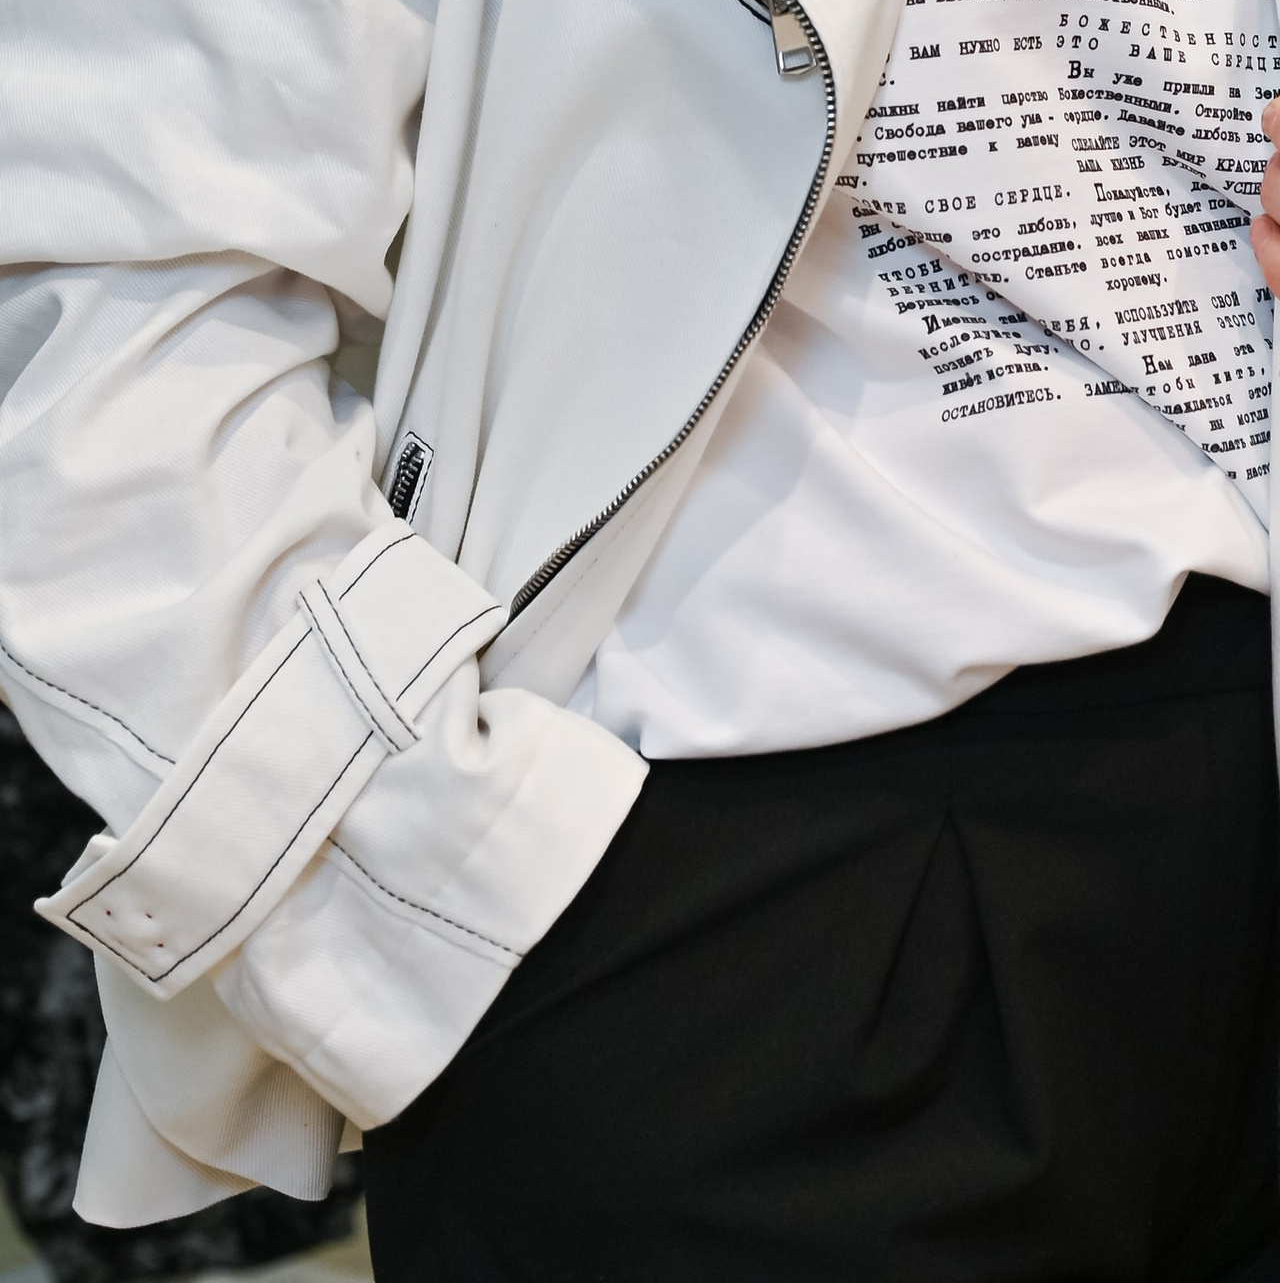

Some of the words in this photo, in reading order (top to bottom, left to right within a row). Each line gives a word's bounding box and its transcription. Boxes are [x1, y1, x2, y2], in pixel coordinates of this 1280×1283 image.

[909, 44, 941, 60] ВАМ
[959, 38, 1000, 55] НУЖНО
[1013, 36, 1042, 51] ЕСТЬ
[1057, 35, 1098, 50] ЭТО
[1129, 44, 1186, 63] ВАШЕ
[1067, 60, 1095, 79] Вы
[1112, 73, 1143, 86] уже
[1163, 81, 1215, 95] пришли
[1229, 87, 1241, 98] на
[937, 96, 986, 112] найти
[1001, 91, 1048, 106] царство
[1058, 84, 1182, 114] Божественными.
[1195, 104, 1252, 122] Откройте
[875, 123, 946, 140] Свобода
[956, 117, 1012, 133] вашего
[1020, 113, 1042, 128] ума
[1064, 110, 1108, 125] сердце.
[1117, 109, 1185, 136] Давайте
[1192, 127, 1240, 142] любовь
[856, 145, 967, 167] путешествие
[989, 141, 998, 152] к
[1016, 134, 1058, 149] вашему
[1072, 136, 1119, 151] СДЕЛАЙТЕ
[1129, 136, 1166, 152] ЭТОТ
[1176, 149, 1205, 166] МИР
[1076, 159, 1103, 173] ВАША
[1110, 156, 1145, 171] ЖИЗНЬ
[925, 196, 976, 213] СВОЕ
[995, 185, 1070, 206] СЕРДЦЕ.
[1094, 183, 1170, 202] Пожалуйста,
[1139, 207, 1158, 219] Бог
[1165, 202, 1201, 218] будет
[858, 223, 882, 239] Вы
[972, 228, 1000, 240] это
[1018, 217, 1076, 235] любовь,
[972, 241, 1081, 263] сострадание.
[1095, 234, 1124, 247] всех
[1100, 252, 1151, 269] всегда
[1166, 240, 1237, 260] помогает
[1025, 262, 1087, 280] Станьте
[1105, 273, 1167, 291] хорошему.
[895, 295, 979, 314] Вернитесь
[1115, 300, 1198, 324] ИСПОЛЬЗУЙТЕ
[1211, 291, 1240, 309] СВОЙ
[1255, 286, 1274, 305] УМ
[922, 314, 986, 334] Именно
[998, 312, 1027, 325] там
[1121, 321, 1203, 346] УЛУЧШЕНИЯ
[1217, 312, 1255, 328] ЭТОГО
[931, 345, 995, 377] познать
[1014, 343, 1059, 355] Душу,
[1142, 355, 1173, 375] Нам
[1188, 352, 1217, 367] дана
[1234, 344, 1255, 356] эта
[986, 363, 1048, 381] истина.
[1212, 366, 1264, 384] жить,
[942, 388, 1061, 422] ОСТАНОВИТЕСЬ.
[1237, 408, 1269, 425] могли
